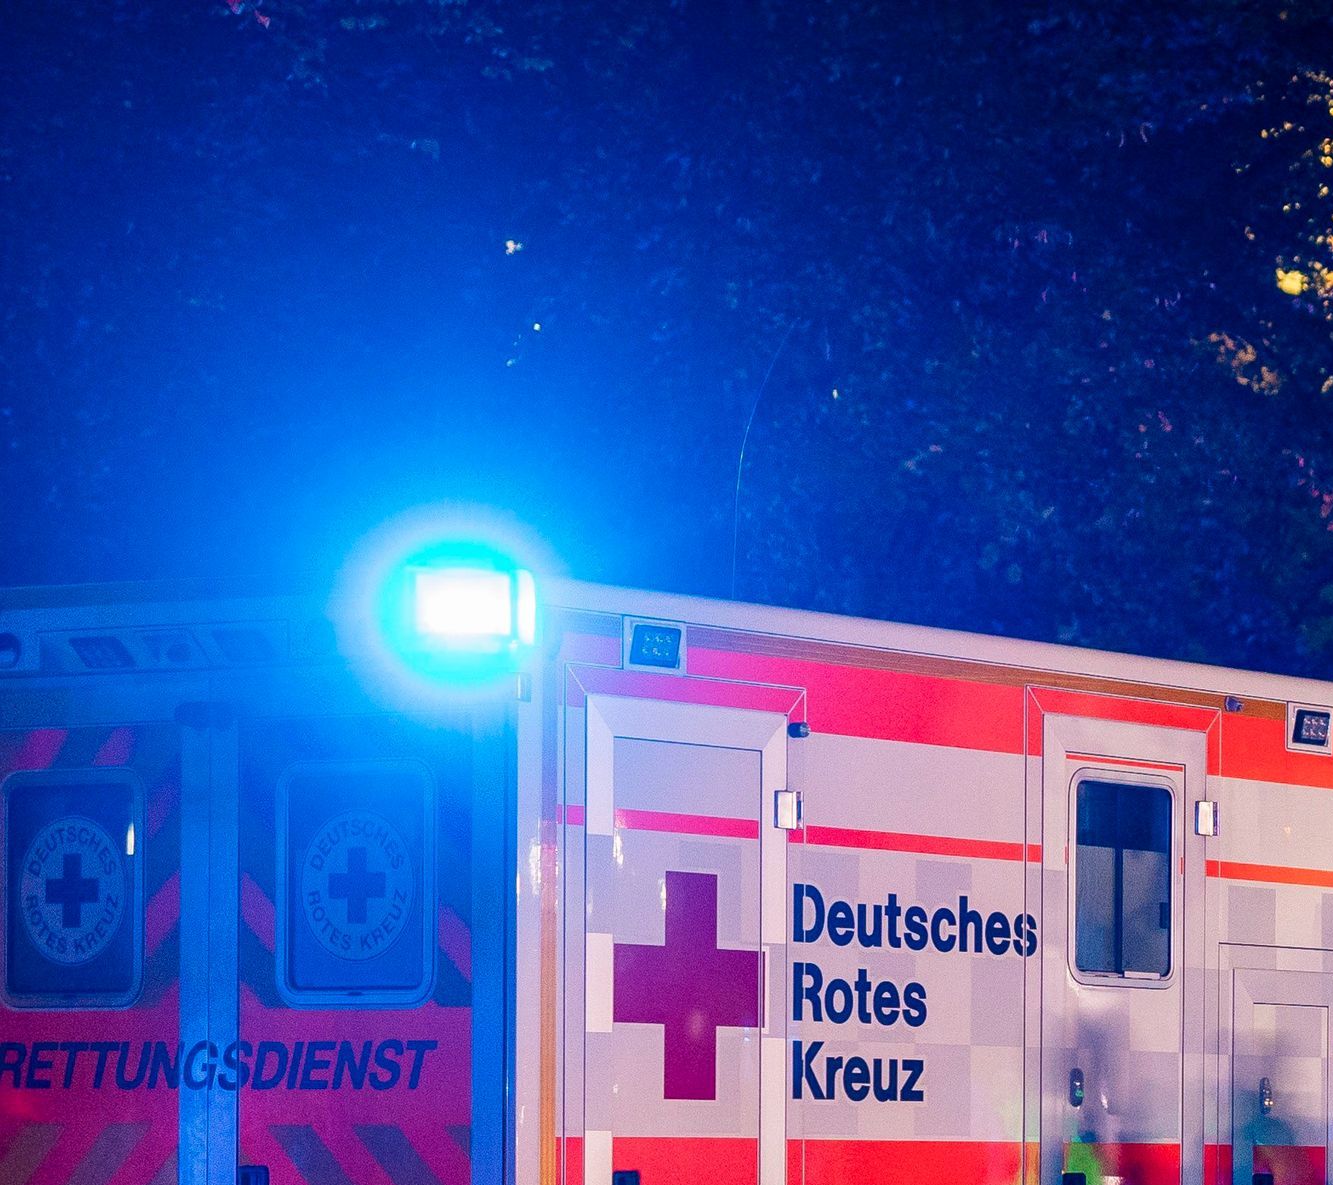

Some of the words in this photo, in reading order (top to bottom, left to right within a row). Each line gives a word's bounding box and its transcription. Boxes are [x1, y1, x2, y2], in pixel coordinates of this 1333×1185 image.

[792, 883, 1038, 958] Deutsches
[792, 961, 928, 1028] Rotes
[0, 1039, 438, 1091] RETTUNGSDIENST
[791, 1040, 925, 1102] Kreuz
